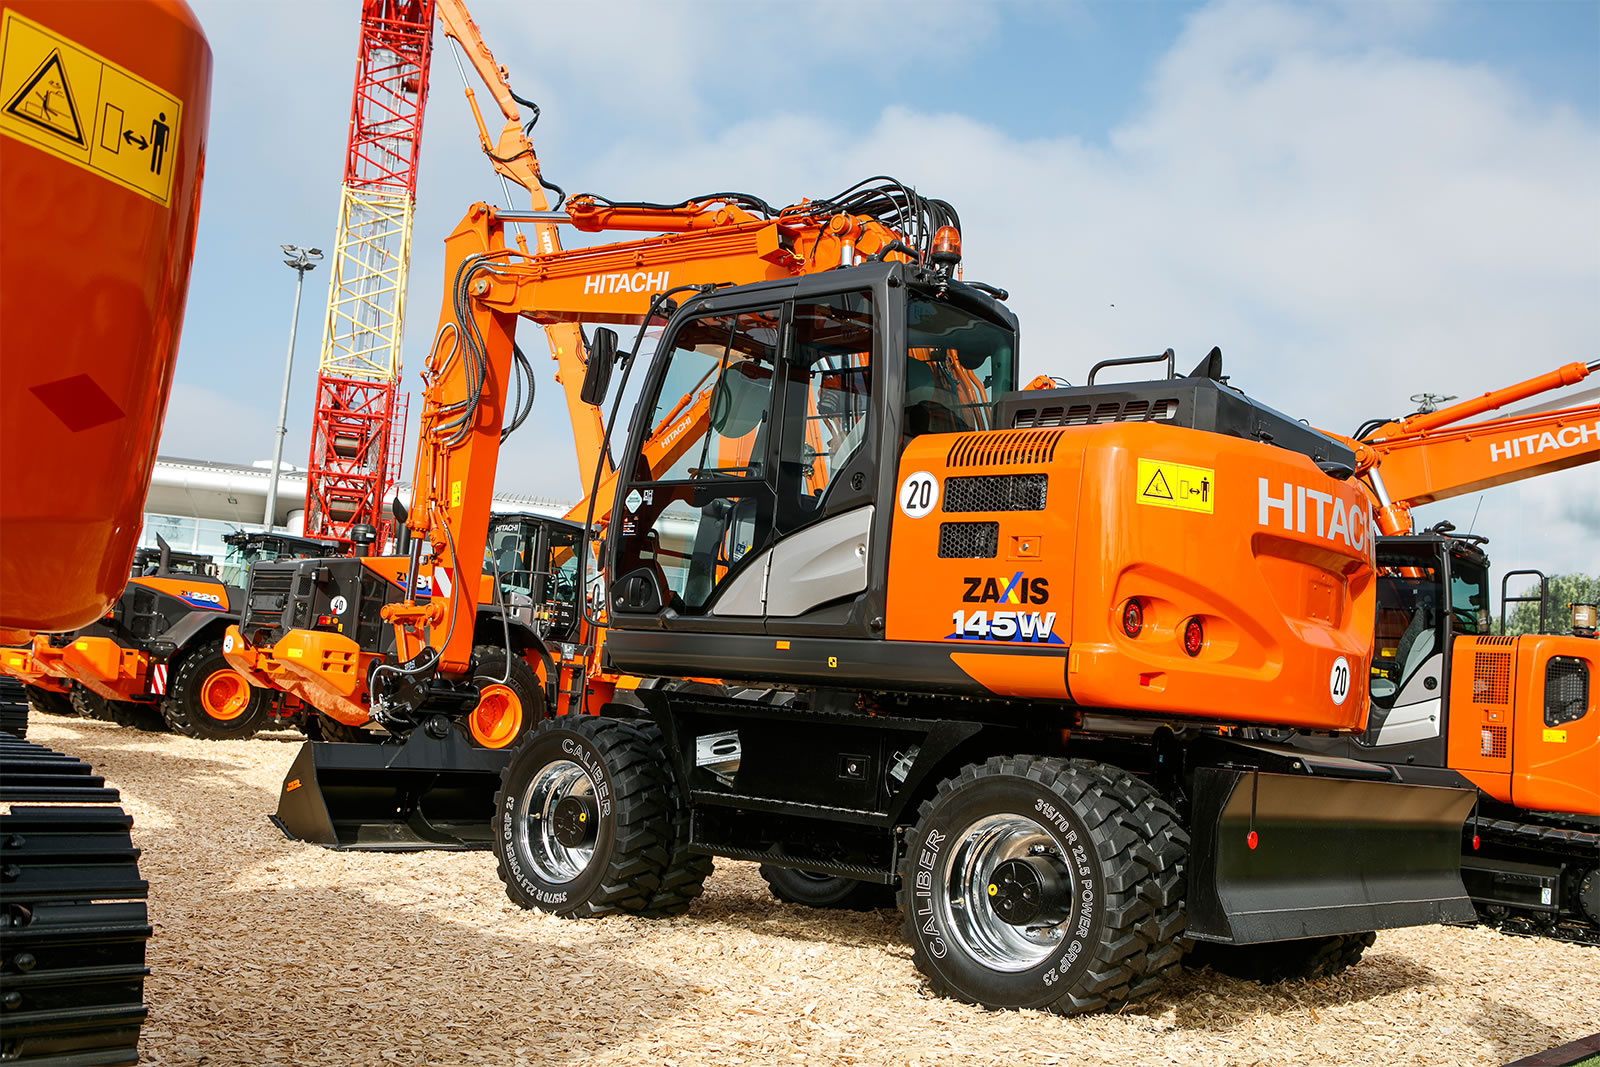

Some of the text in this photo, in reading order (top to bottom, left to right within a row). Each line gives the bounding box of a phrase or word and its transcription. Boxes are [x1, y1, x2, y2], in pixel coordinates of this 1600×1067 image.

[583, 271, 669, 295] HITACHI
[660, 416, 692, 449] HITACHI
[1489, 421, 1600, 462] HITACH
[905, 480, 932, 510] 20
[962, 571, 1049, 605] ZAXIS
[334, 600, 344, 610] 40
[953, 609, 1056, 643] 145W
[1333, 665, 1348, 697] 20
[561, 738, 611, 818] CALIBER
[506, 796, 515, 811] 23
[504, 811, 513, 841] GRIP
[505, 841, 525, 882] POWER
[521, 878, 538, 896] 22.5
[536, 889, 544, 901] R
[915, 828, 948, 959] CALIBER
[1034, 798, 1094, 987] 315/70 R 22.5 POWER GRIP 23
